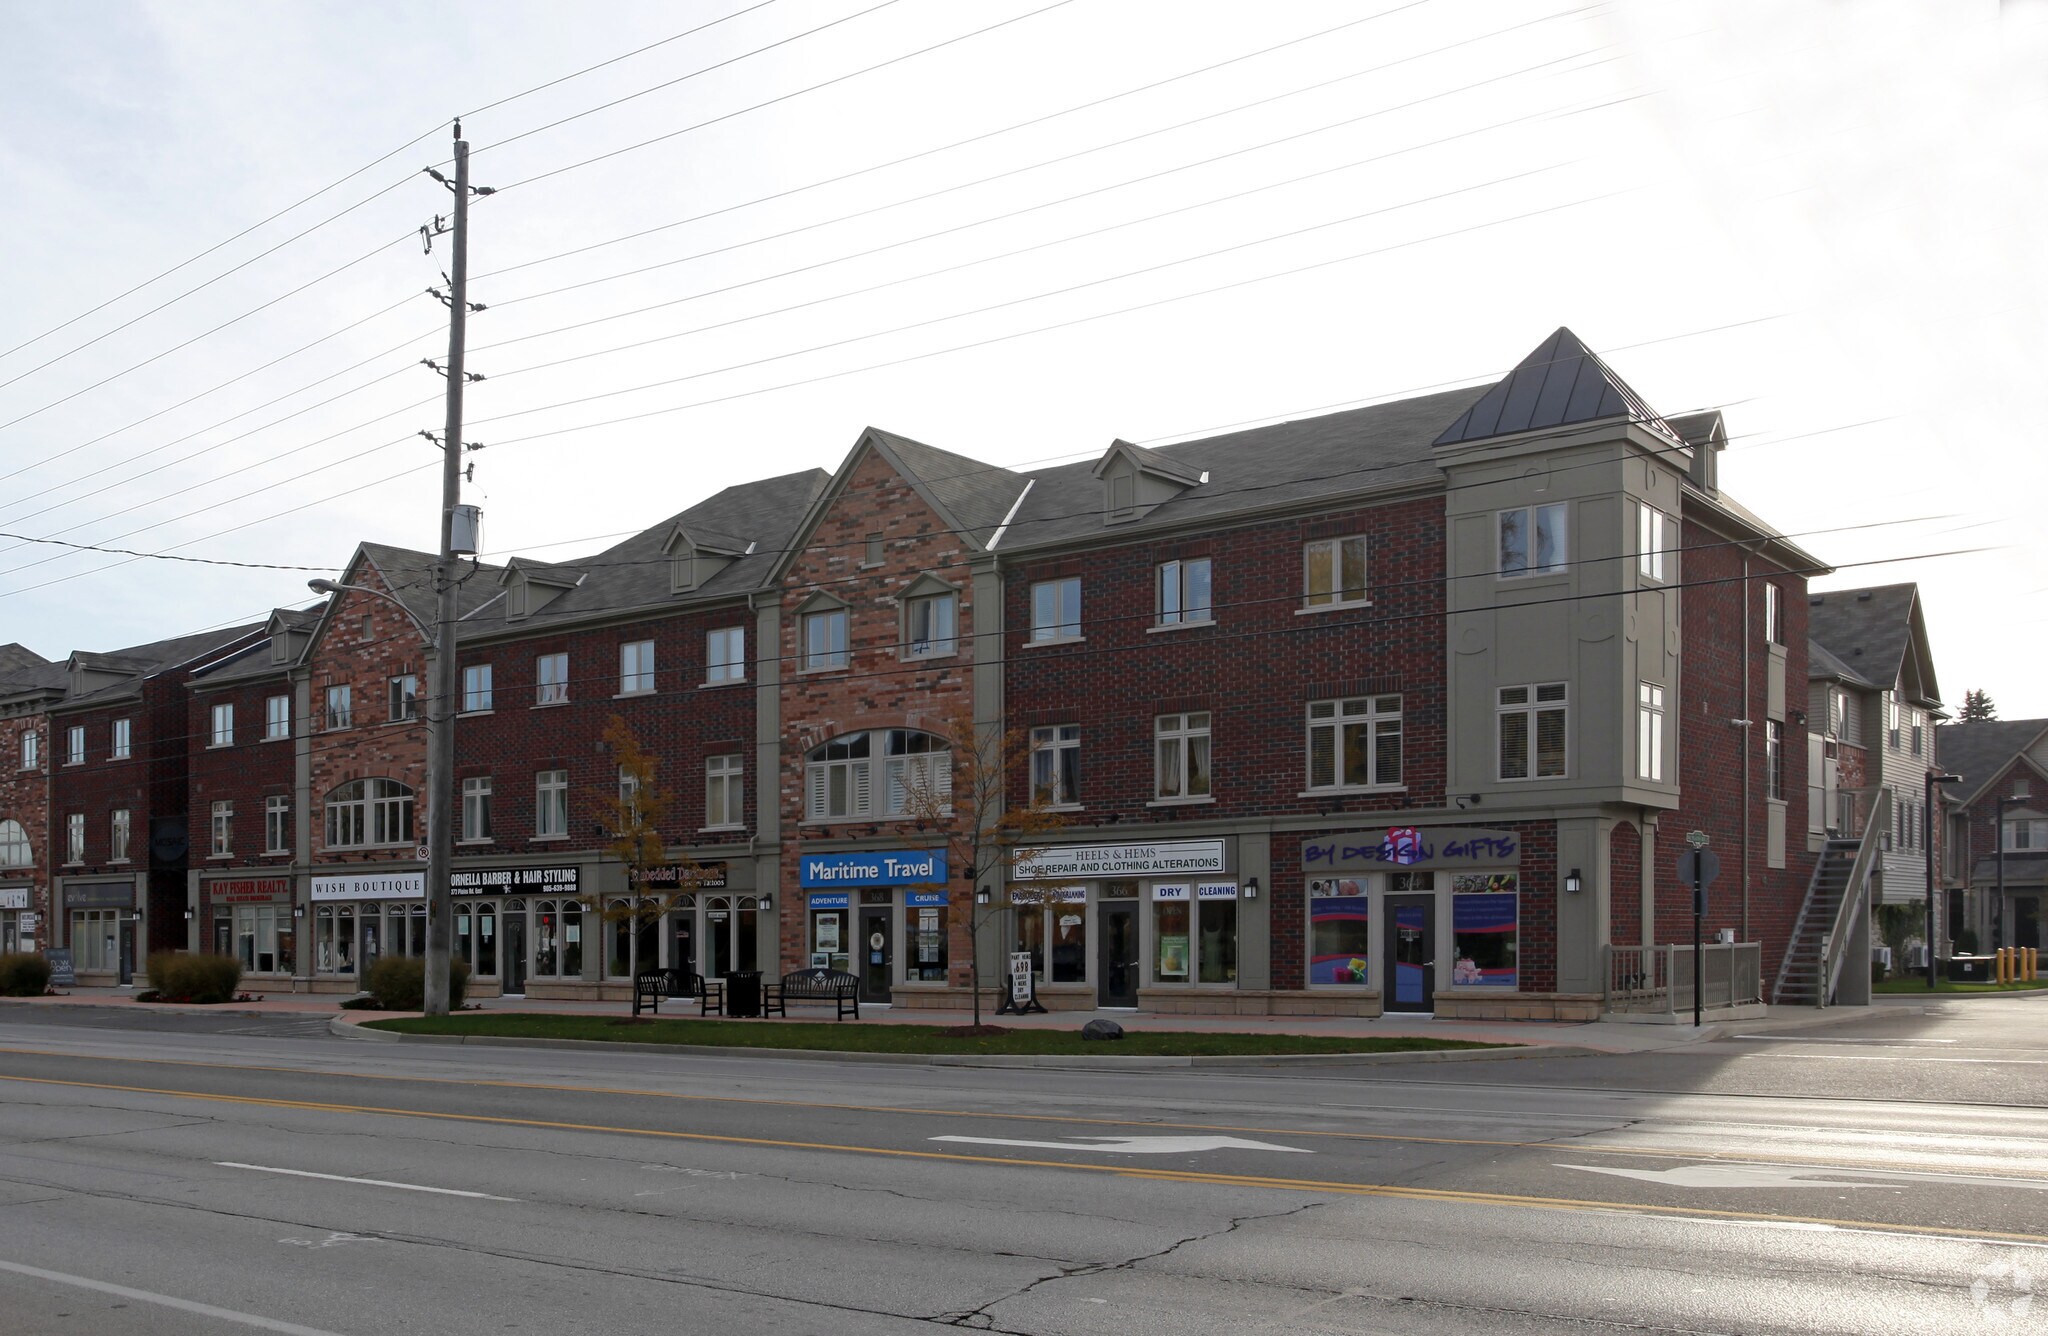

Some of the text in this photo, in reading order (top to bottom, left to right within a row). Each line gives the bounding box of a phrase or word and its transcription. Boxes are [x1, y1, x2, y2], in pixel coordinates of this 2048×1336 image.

[1075, 848, 1156, 861] HEELS & HEMS
[1305, 836, 1517, 864] BY DESIGN GIFTS
[809, 857, 933, 880] Maritime Travel
[1018, 857, 1219, 875] SHOE REPAIR AND CLOTHING ALTERATIONS
[450, 868, 577, 887] ORNELLA BARBER & HAIR STYLING
[213, 882, 229, 895] KAY
[229, 880, 255, 895] FISHER
[316, 879, 420, 893] WISH BOUTIQUE
[1159, 886, 1236, 897] DRY CLEANING
[811, 894, 940, 905] ADVENTURE CRUISE
